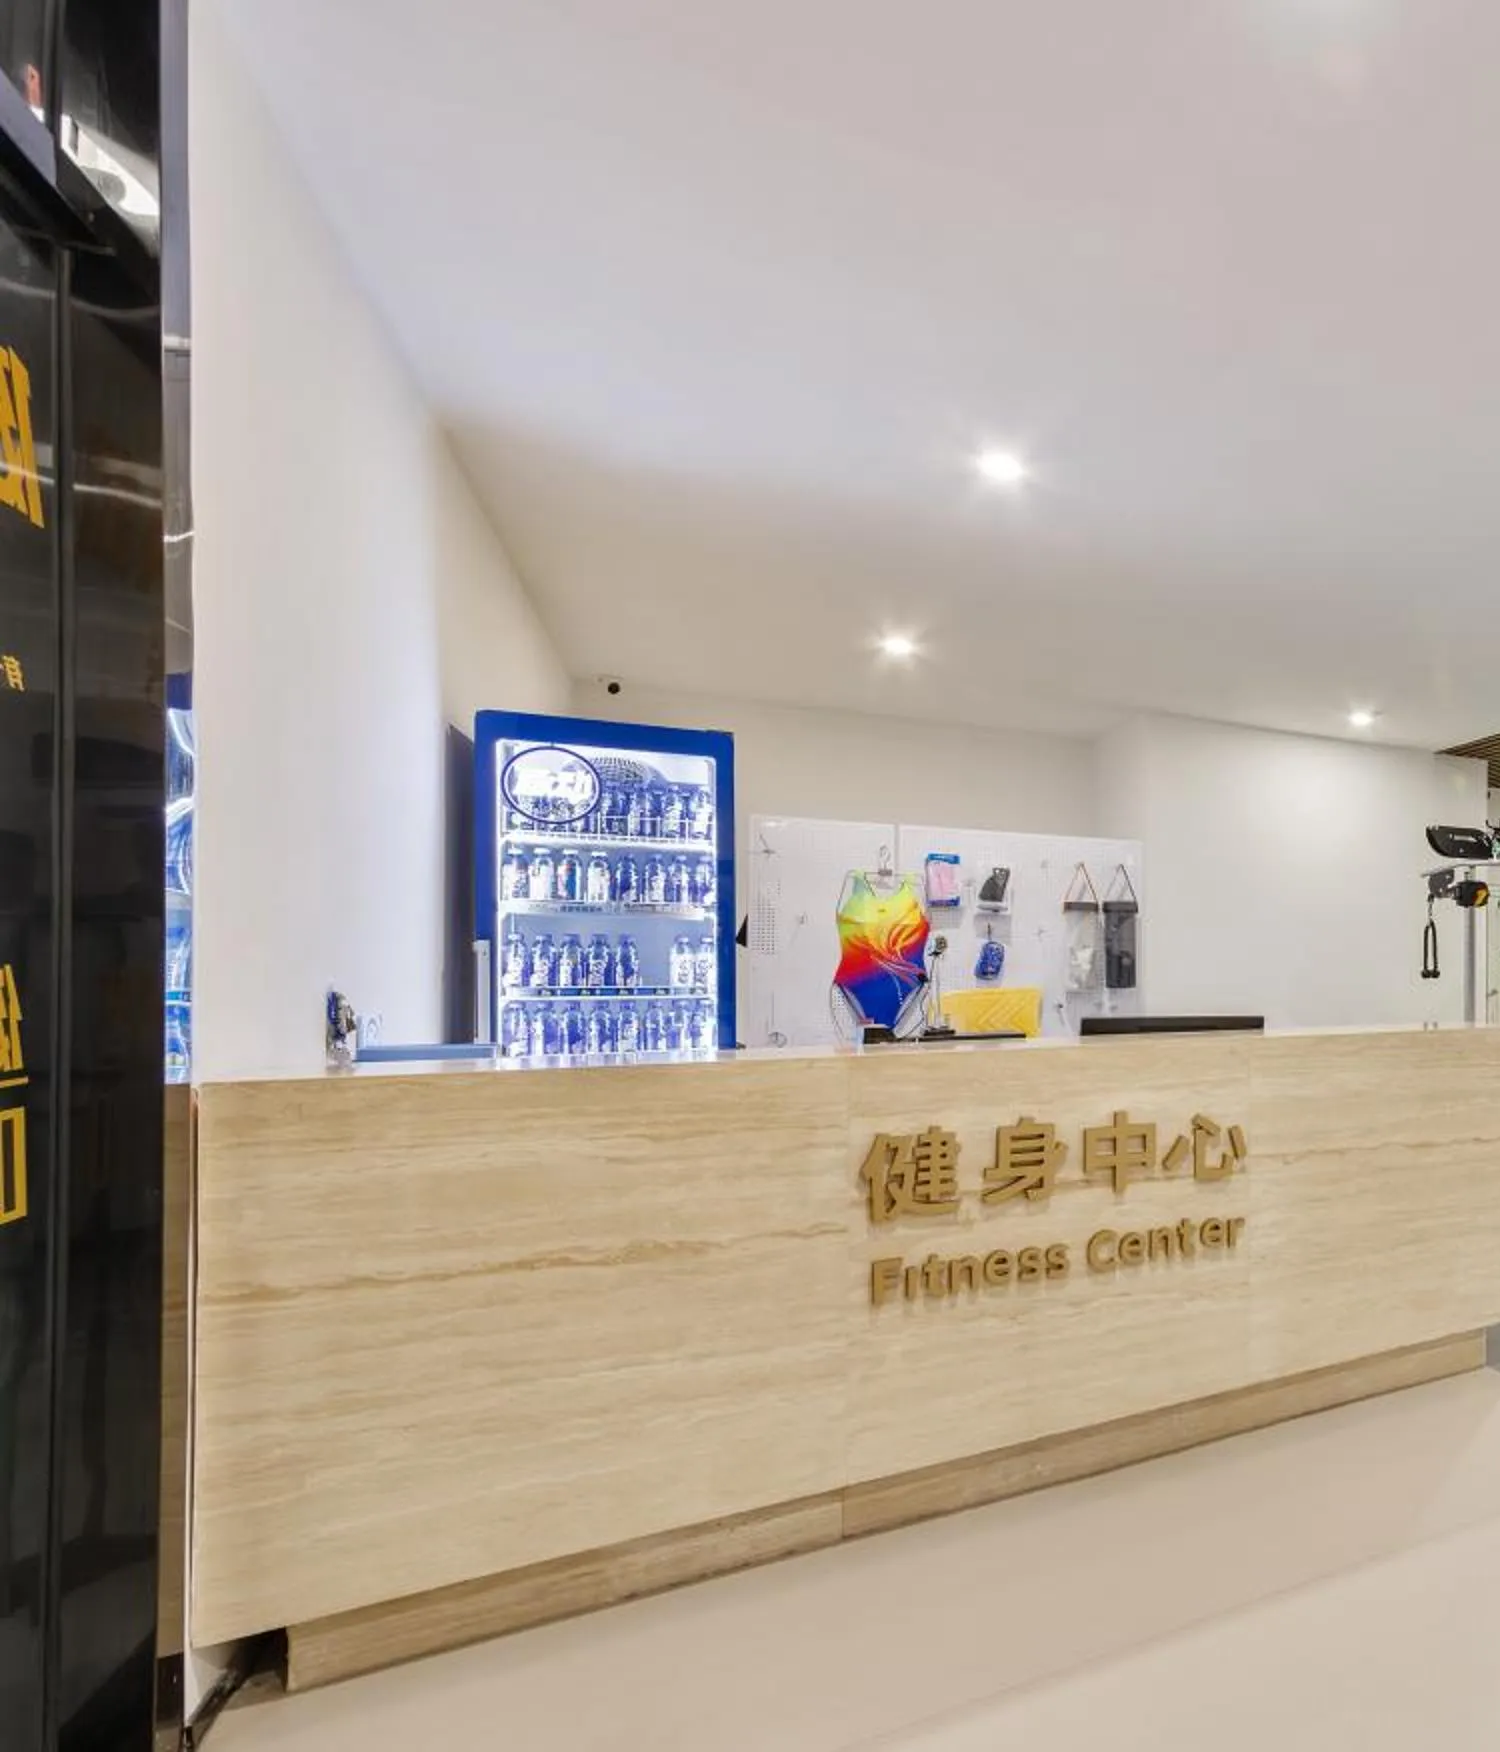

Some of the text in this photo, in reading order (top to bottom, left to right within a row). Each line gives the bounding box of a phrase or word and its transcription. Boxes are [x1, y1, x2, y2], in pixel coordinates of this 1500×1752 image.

[860, 1110, 1247, 1223] 健身中心
[1087, 1217, 1245, 1271] Center
